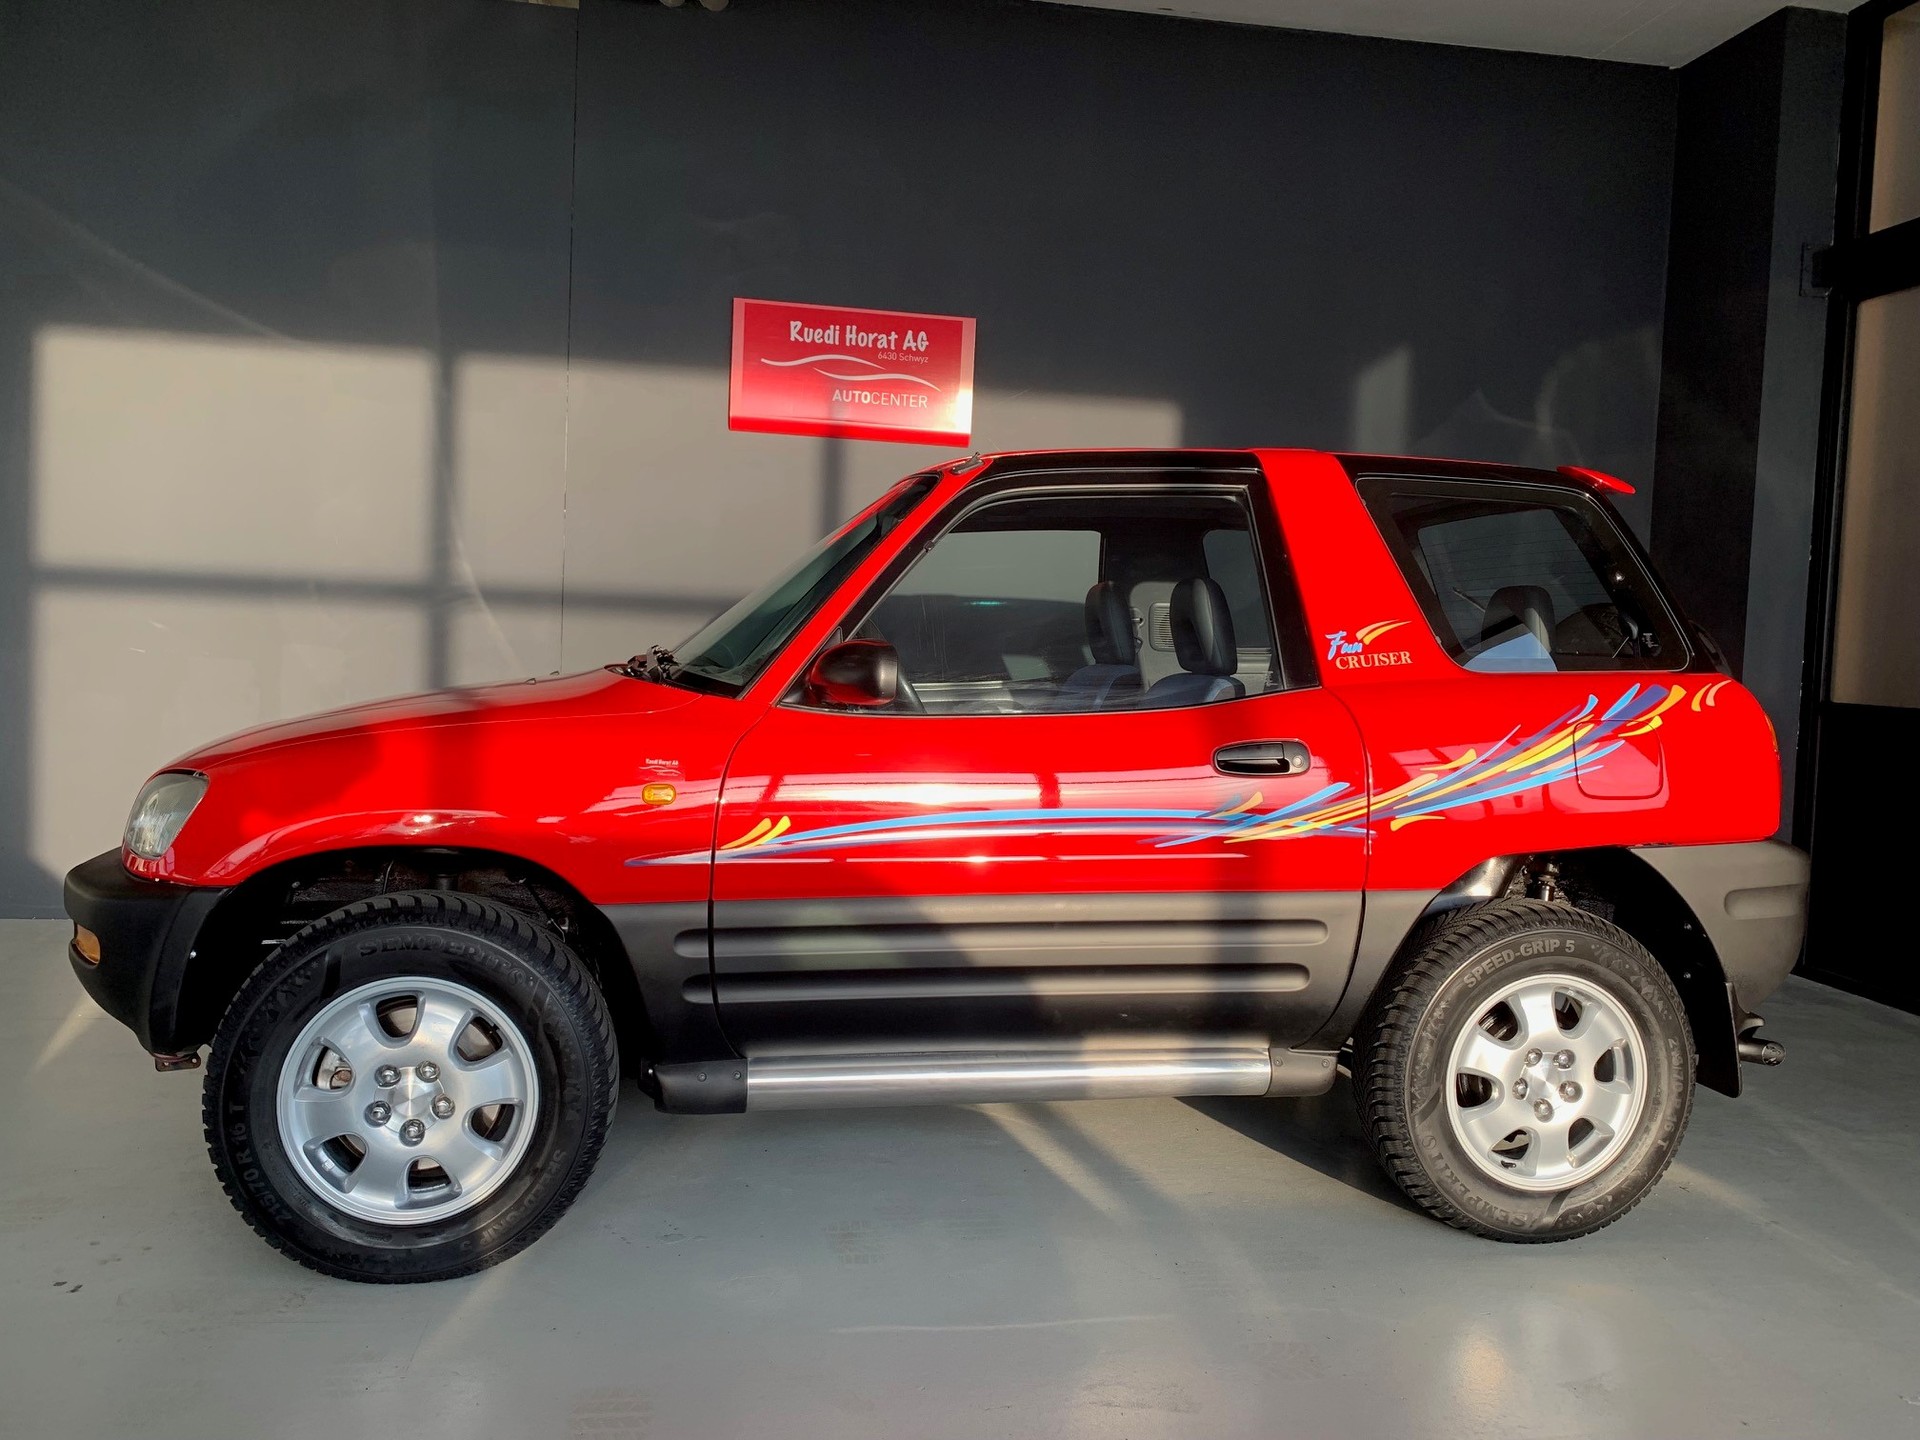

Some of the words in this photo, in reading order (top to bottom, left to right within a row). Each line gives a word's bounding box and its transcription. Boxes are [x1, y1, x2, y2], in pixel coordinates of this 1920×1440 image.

[789, 320, 840, 345] Ruedi
[845, 325, 898, 350] Horat
[903, 330, 929, 352] AG
[877, 352, 898, 361] 6430
[900, 353, 929, 364] Schwyz
[832, 389, 928, 408] AUTOCENTER
[1325, 630, 1363, 661] Fun
[1335, 651, 1413, 670] CRUISER
[1463, 939, 1561, 988] SPEED-GRIP
[1565, 940, 1575, 953] 5
[1431, 1152, 1529, 1228] SEMPERIT
